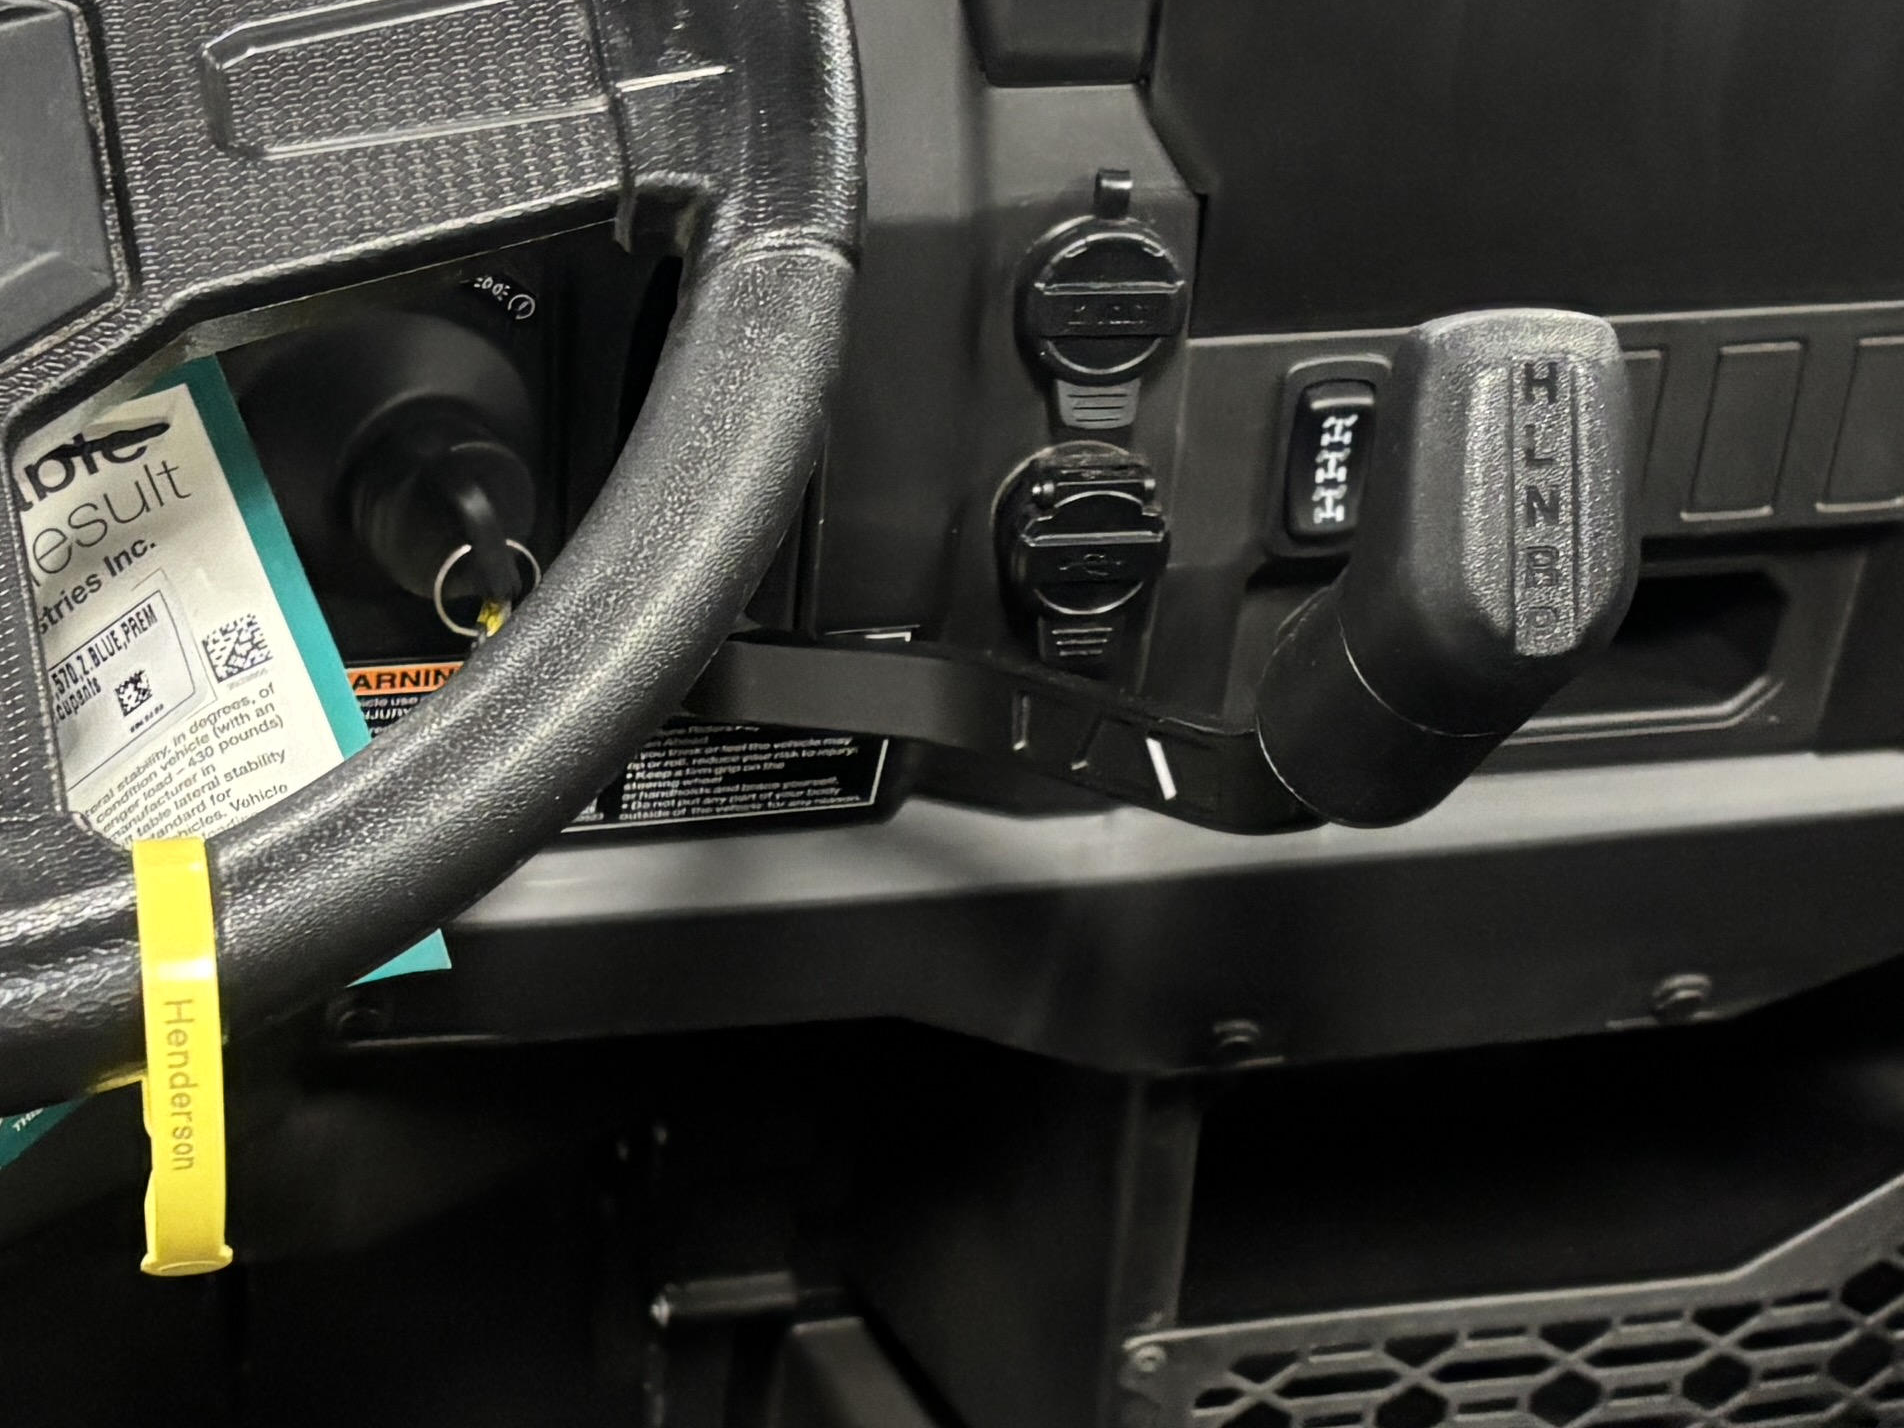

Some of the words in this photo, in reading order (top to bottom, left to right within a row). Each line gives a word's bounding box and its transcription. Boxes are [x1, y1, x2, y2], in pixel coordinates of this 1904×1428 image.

[30, 460, 193, 588] esult
[103, 539, 156, 577] Inc.
[352, 668, 456, 690] ARNIN
[173, 732, 187, 748] in
[259, 682, 275, 699] of
[96, 771, 158, 824] condition
[160, 733, 210, 772] vehicle
[212, 711, 251, 740] (with
[255, 701, 276, 719] an
[103, 798, 140, 833] enger
[143, 773, 173, 801] load
[188, 745, 215, 769] 430
[217, 714, 284, 754] pounds)
[174, 775, 221, 811] lateral
[223, 749, 286, 783] stability
[200, 762, 216, 777] in
[175, 808, 227, 839] hicles.
[229, 784, 288, 813] Vehicle
[210, 786, 232, 806] for
[163, 997, 199, 1172] Henderson
